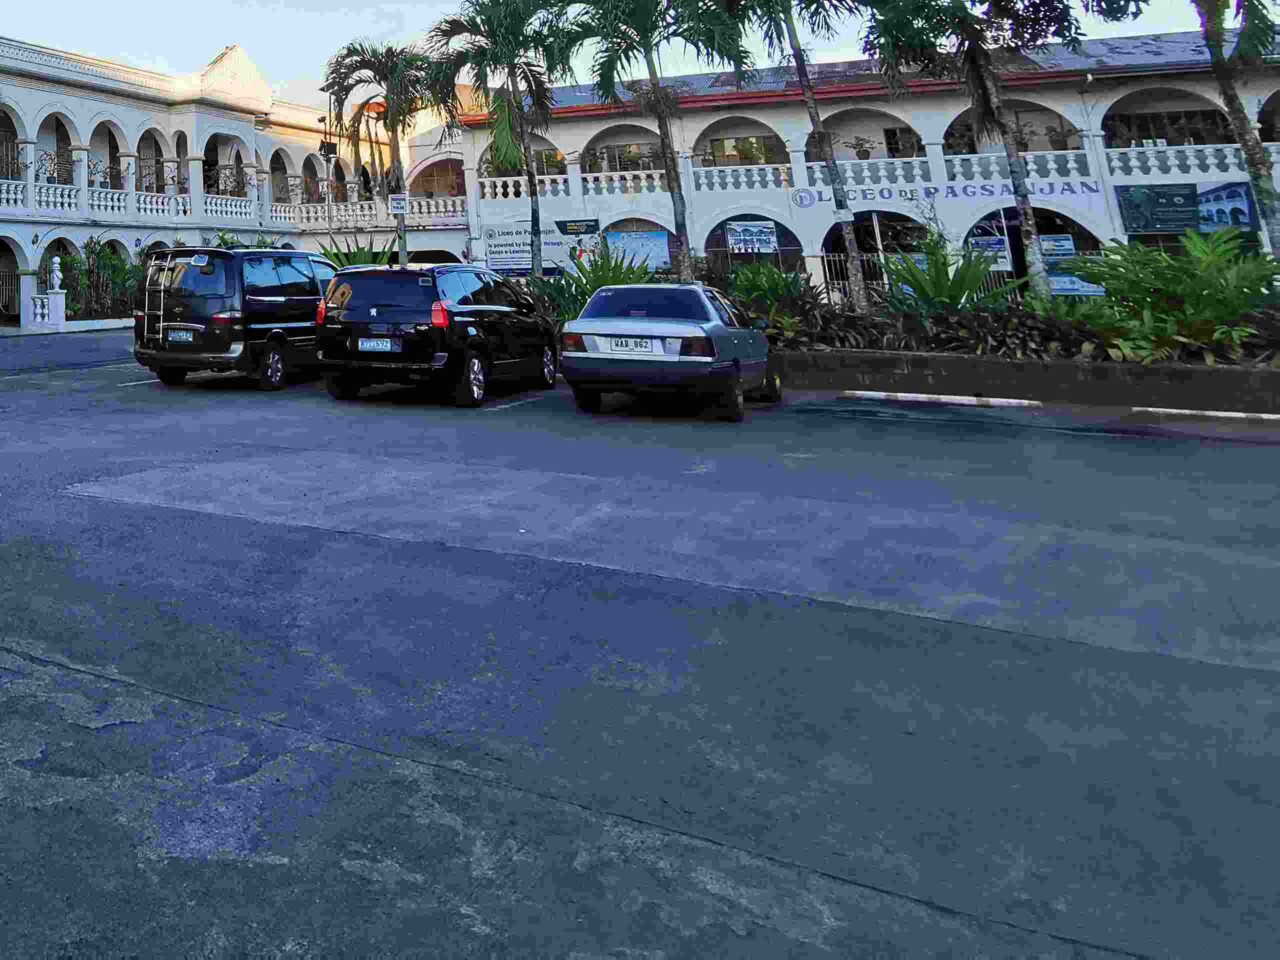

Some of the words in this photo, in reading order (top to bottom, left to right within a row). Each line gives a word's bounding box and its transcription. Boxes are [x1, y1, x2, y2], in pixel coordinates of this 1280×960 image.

[817, 188, 893, 201] LCEO
[898, 189, 919, 200] DE
[523, 229, 555, 237] Panjan
